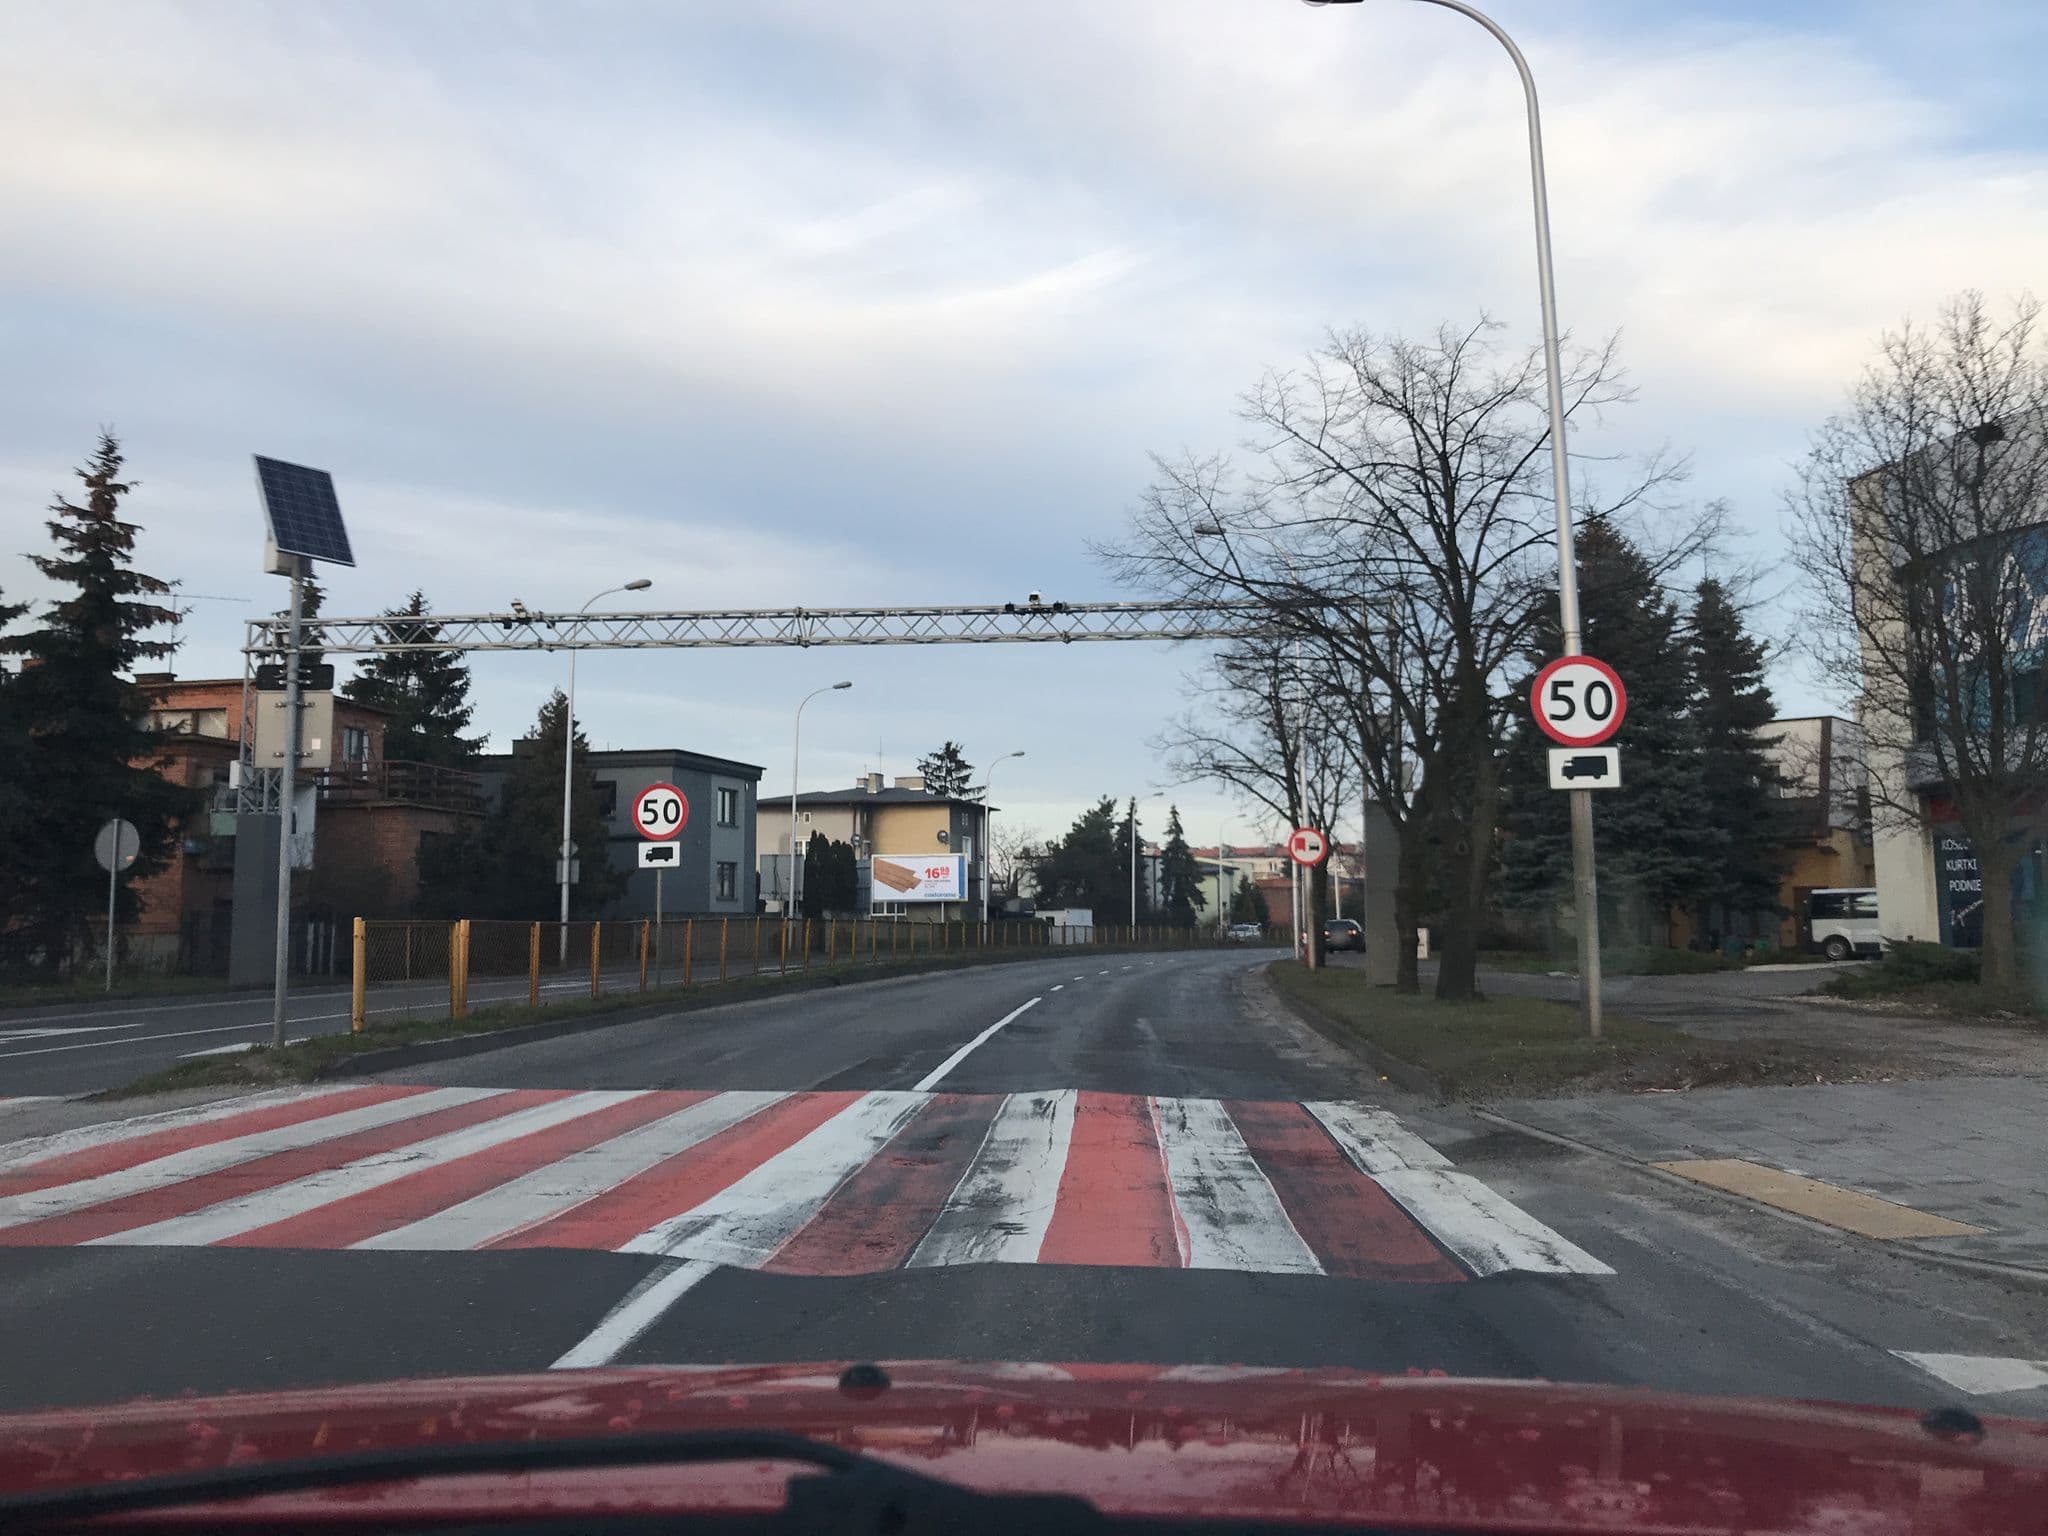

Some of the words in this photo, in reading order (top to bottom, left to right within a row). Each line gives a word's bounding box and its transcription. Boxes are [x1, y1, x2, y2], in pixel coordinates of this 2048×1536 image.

[1549, 680, 1613, 721] 50
[642, 798, 681, 825] 50
[924, 867, 940, 879] 16
[1945, 858, 1977, 871] KURTKI
